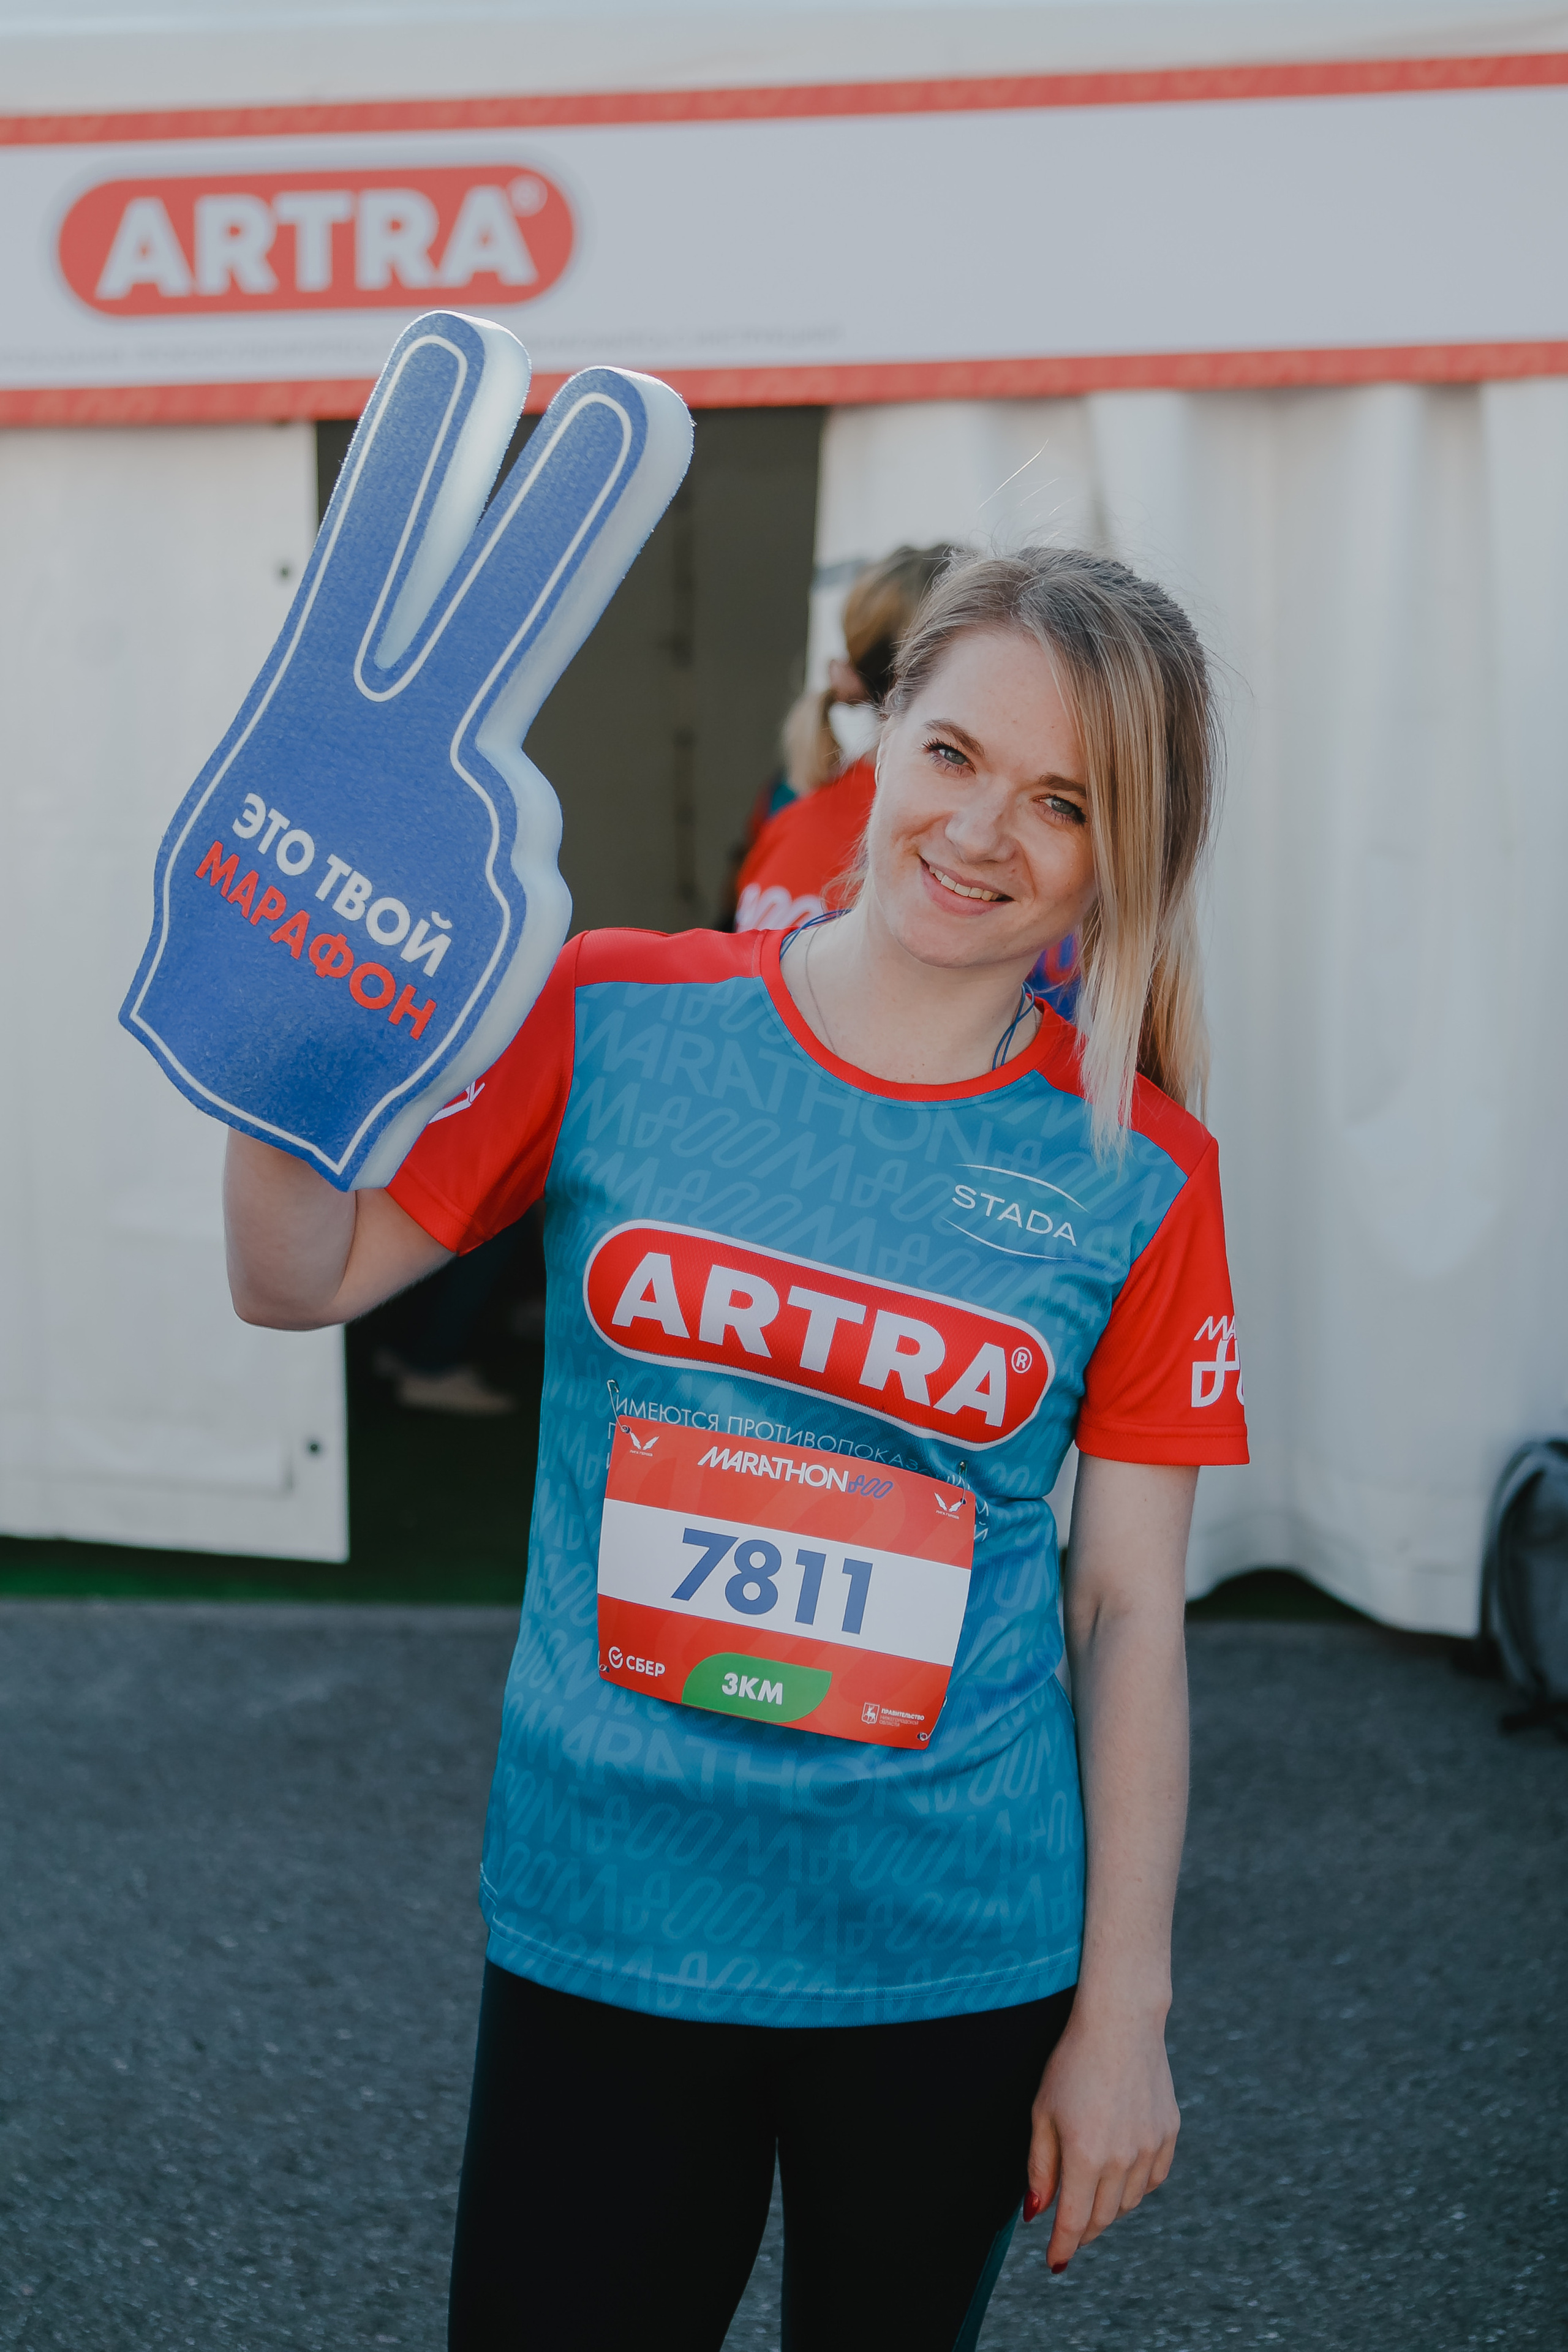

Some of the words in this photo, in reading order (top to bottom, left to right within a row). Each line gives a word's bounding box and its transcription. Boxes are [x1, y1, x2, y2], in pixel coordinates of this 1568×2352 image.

[232, 792, 315, 876] ЭТО
[315, 853, 453, 978] ТВОЙ
[194, 840, 437, 1041] МАРАФОН
[951, 1184, 1077, 1247] STADA
[615, 1394, 719, 1432] ИМЕЮТСЯ
[670, 1527, 873, 1635] 7811
[625, 1655, 666, 1678] СБЕР
[881, 1708, 925, 1721] ПРАВИТЕЛЬСТВО
